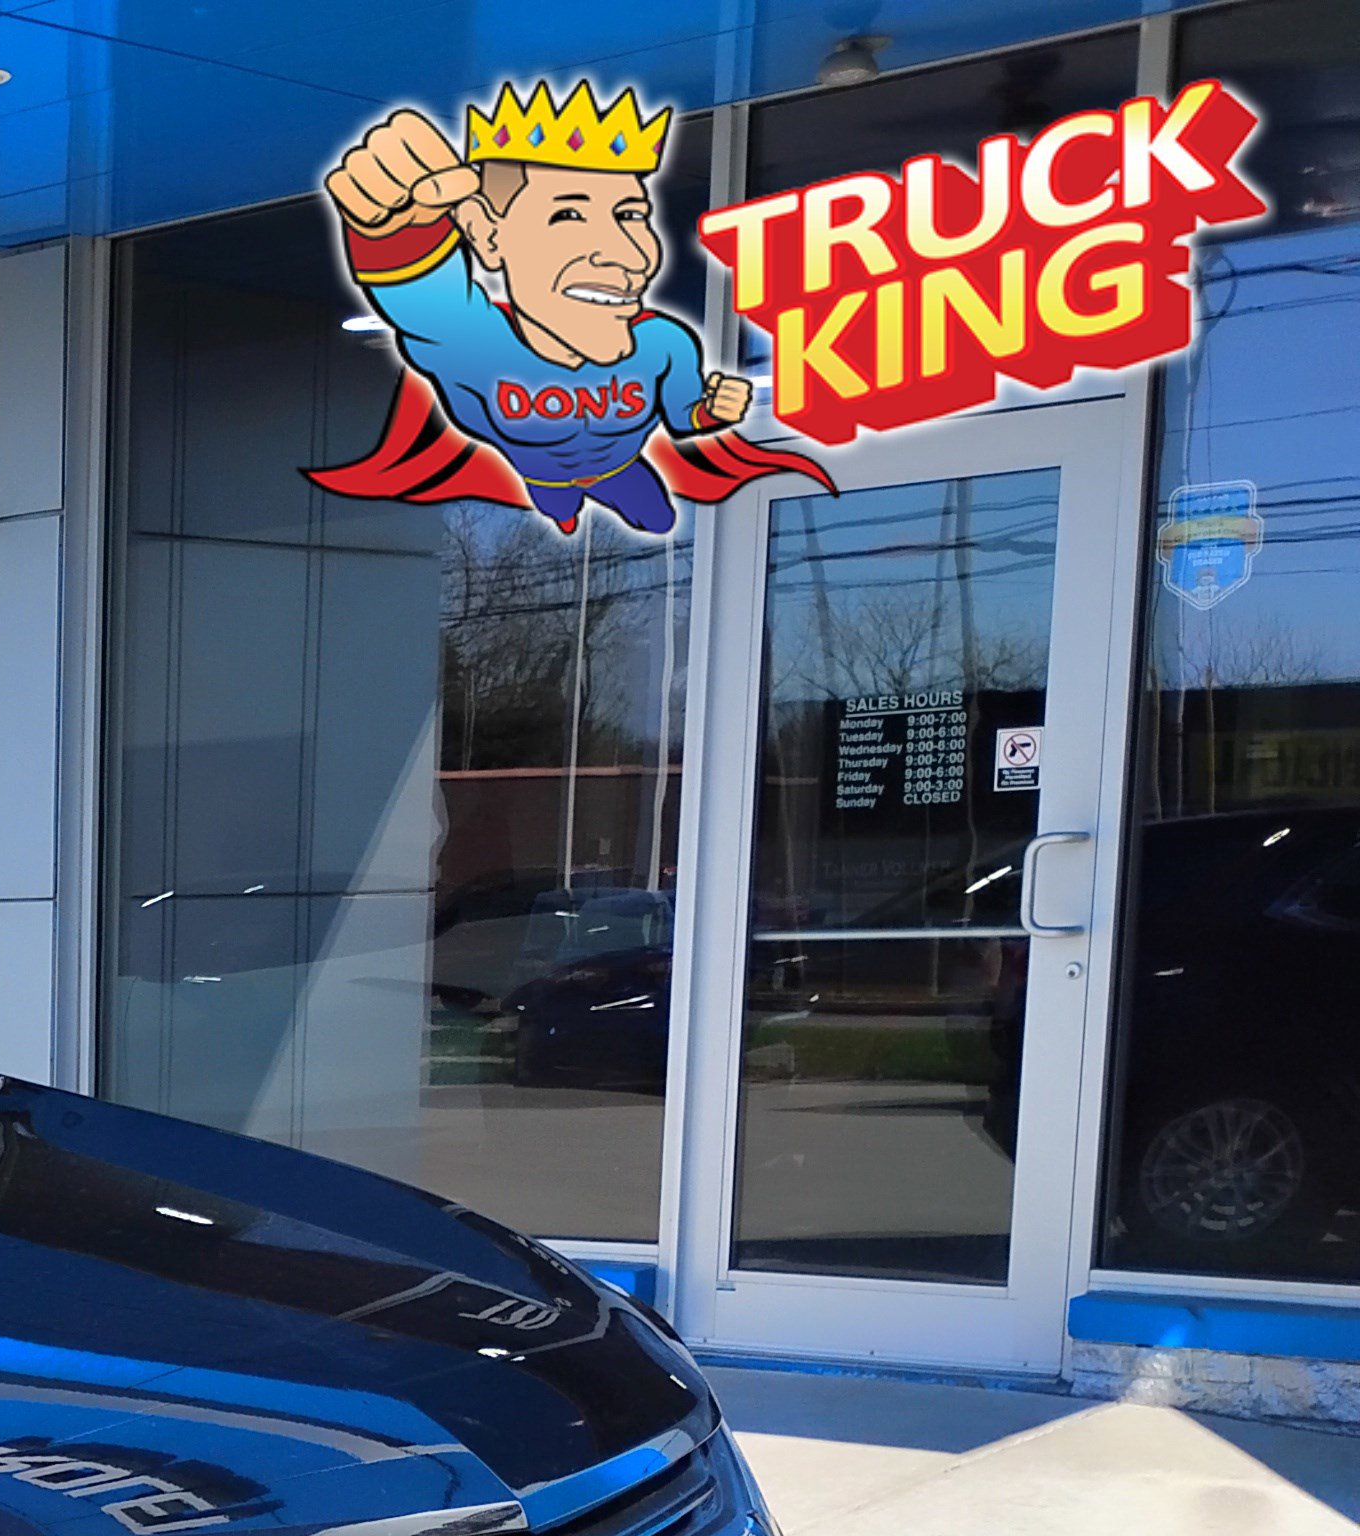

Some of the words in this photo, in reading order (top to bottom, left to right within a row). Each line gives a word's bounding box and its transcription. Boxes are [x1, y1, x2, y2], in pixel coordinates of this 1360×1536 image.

[845, 695, 900, 712] SALES
[903, 690, 964, 708] HOURS
[840, 717, 884, 730] Monday
[907, 711, 968, 727] 9:00-7:00
[839, 730, 884, 742] Tuesday
[906, 724, 967, 740] 9:00-6:00
[838, 742, 903, 756] Wednesday
[838, 756, 889, 769] Thursday
[905, 751, 965, 767] 9:00-7:00
[837, 770, 872, 783] Friday
[904, 764, 965, 780] 9:00-6:00
[836, 783, 885, 796] Saturday
[903, 778, 964, 793] 9:00-3:00
[835, 796, 877, 809] Sunday
[903, 790, 961, 805] CLOSED
